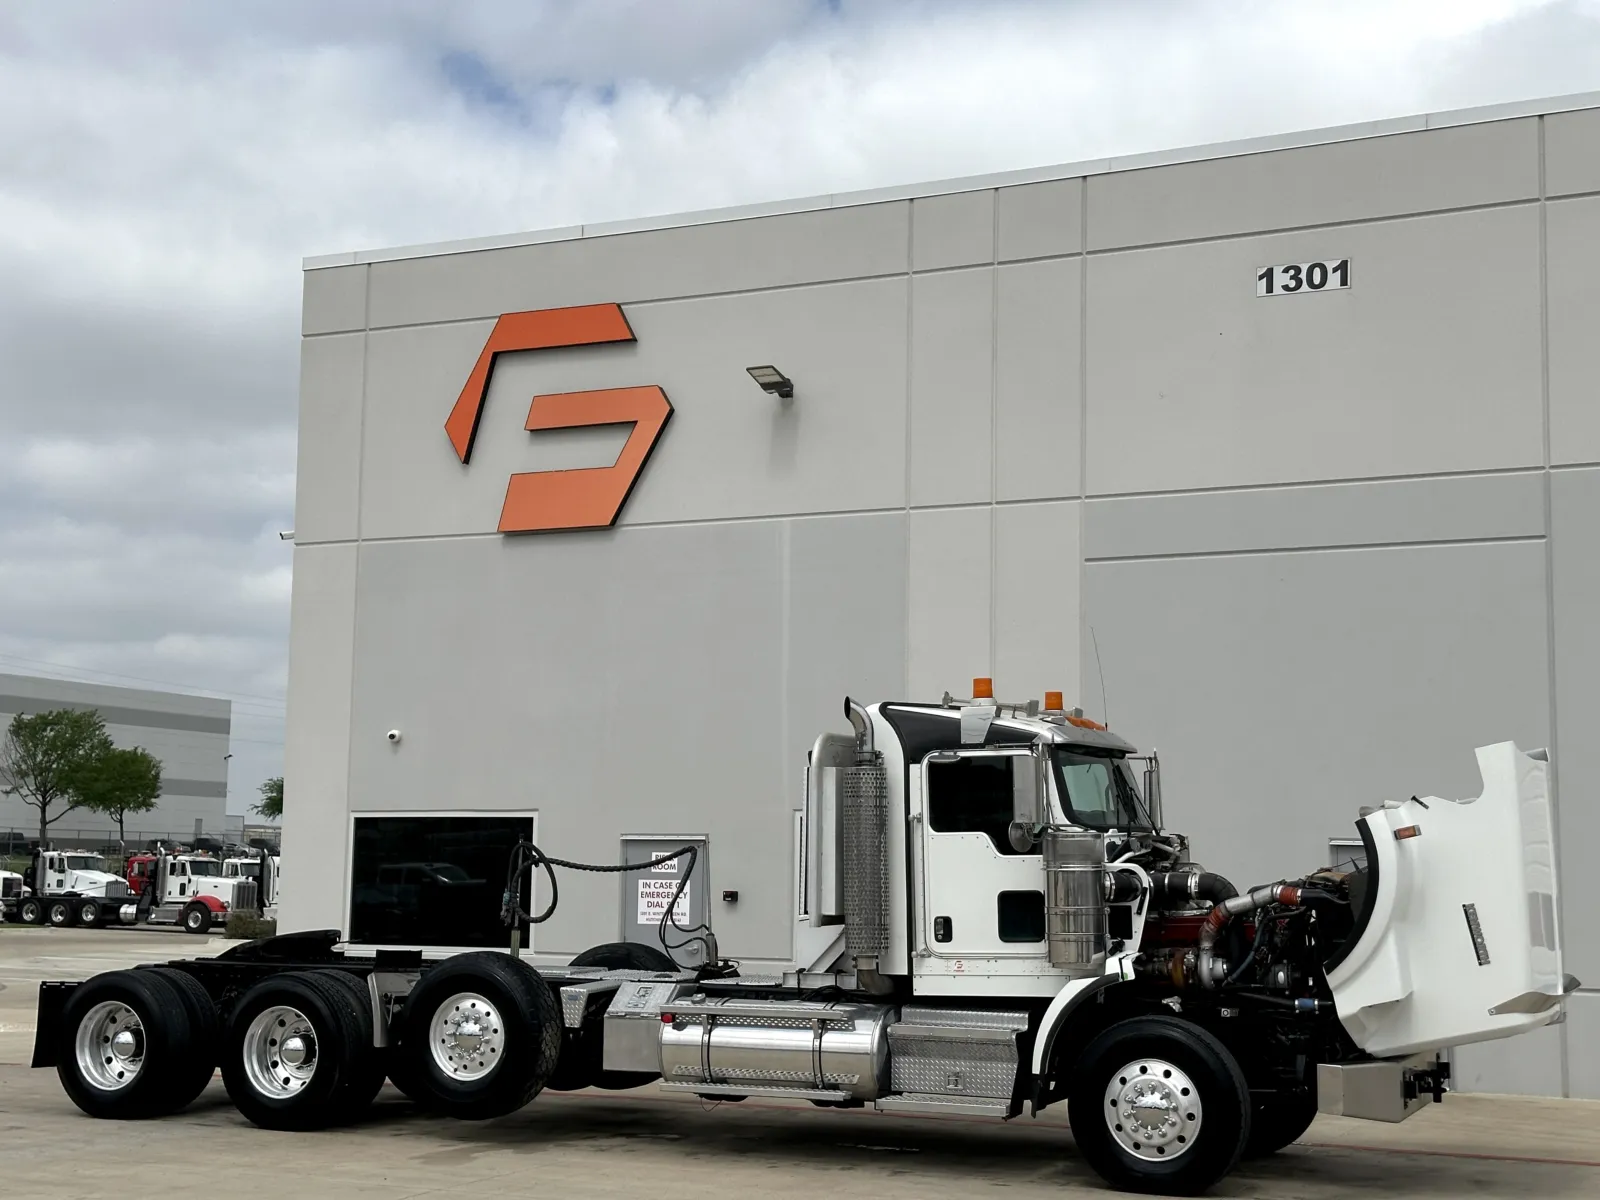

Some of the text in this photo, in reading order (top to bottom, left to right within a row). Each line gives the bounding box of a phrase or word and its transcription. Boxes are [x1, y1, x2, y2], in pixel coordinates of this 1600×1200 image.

[1258, 259, 1348, 294] 1301
[642, 881, 651, 889] IN
[653, 881, 673, 889] CASE
